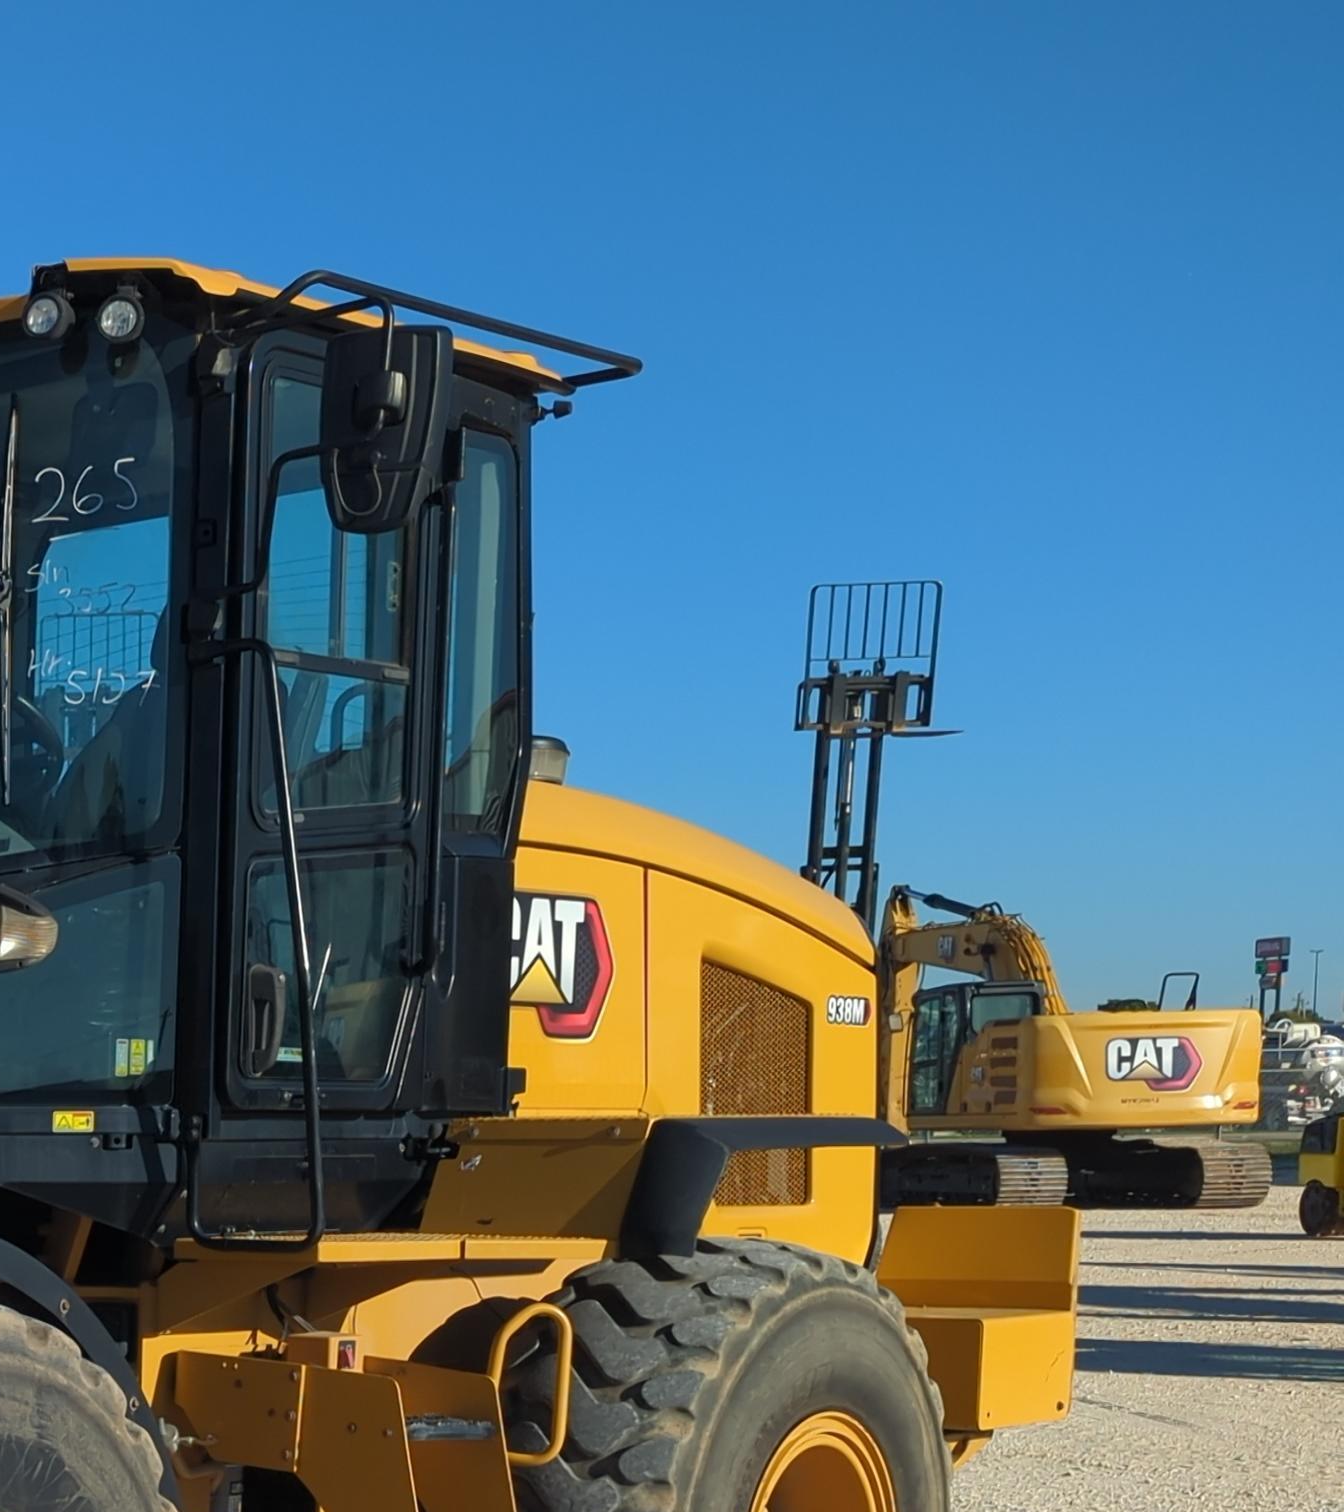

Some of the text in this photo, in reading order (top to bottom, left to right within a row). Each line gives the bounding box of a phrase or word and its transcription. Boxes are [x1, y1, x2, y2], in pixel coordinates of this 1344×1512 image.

[31, 457, 138, 523] 265
[57, 582, 144, 616] 3552
[828, 996, 866, 1024] 938M
[1107, 1038, 1179, 1080] CAT
